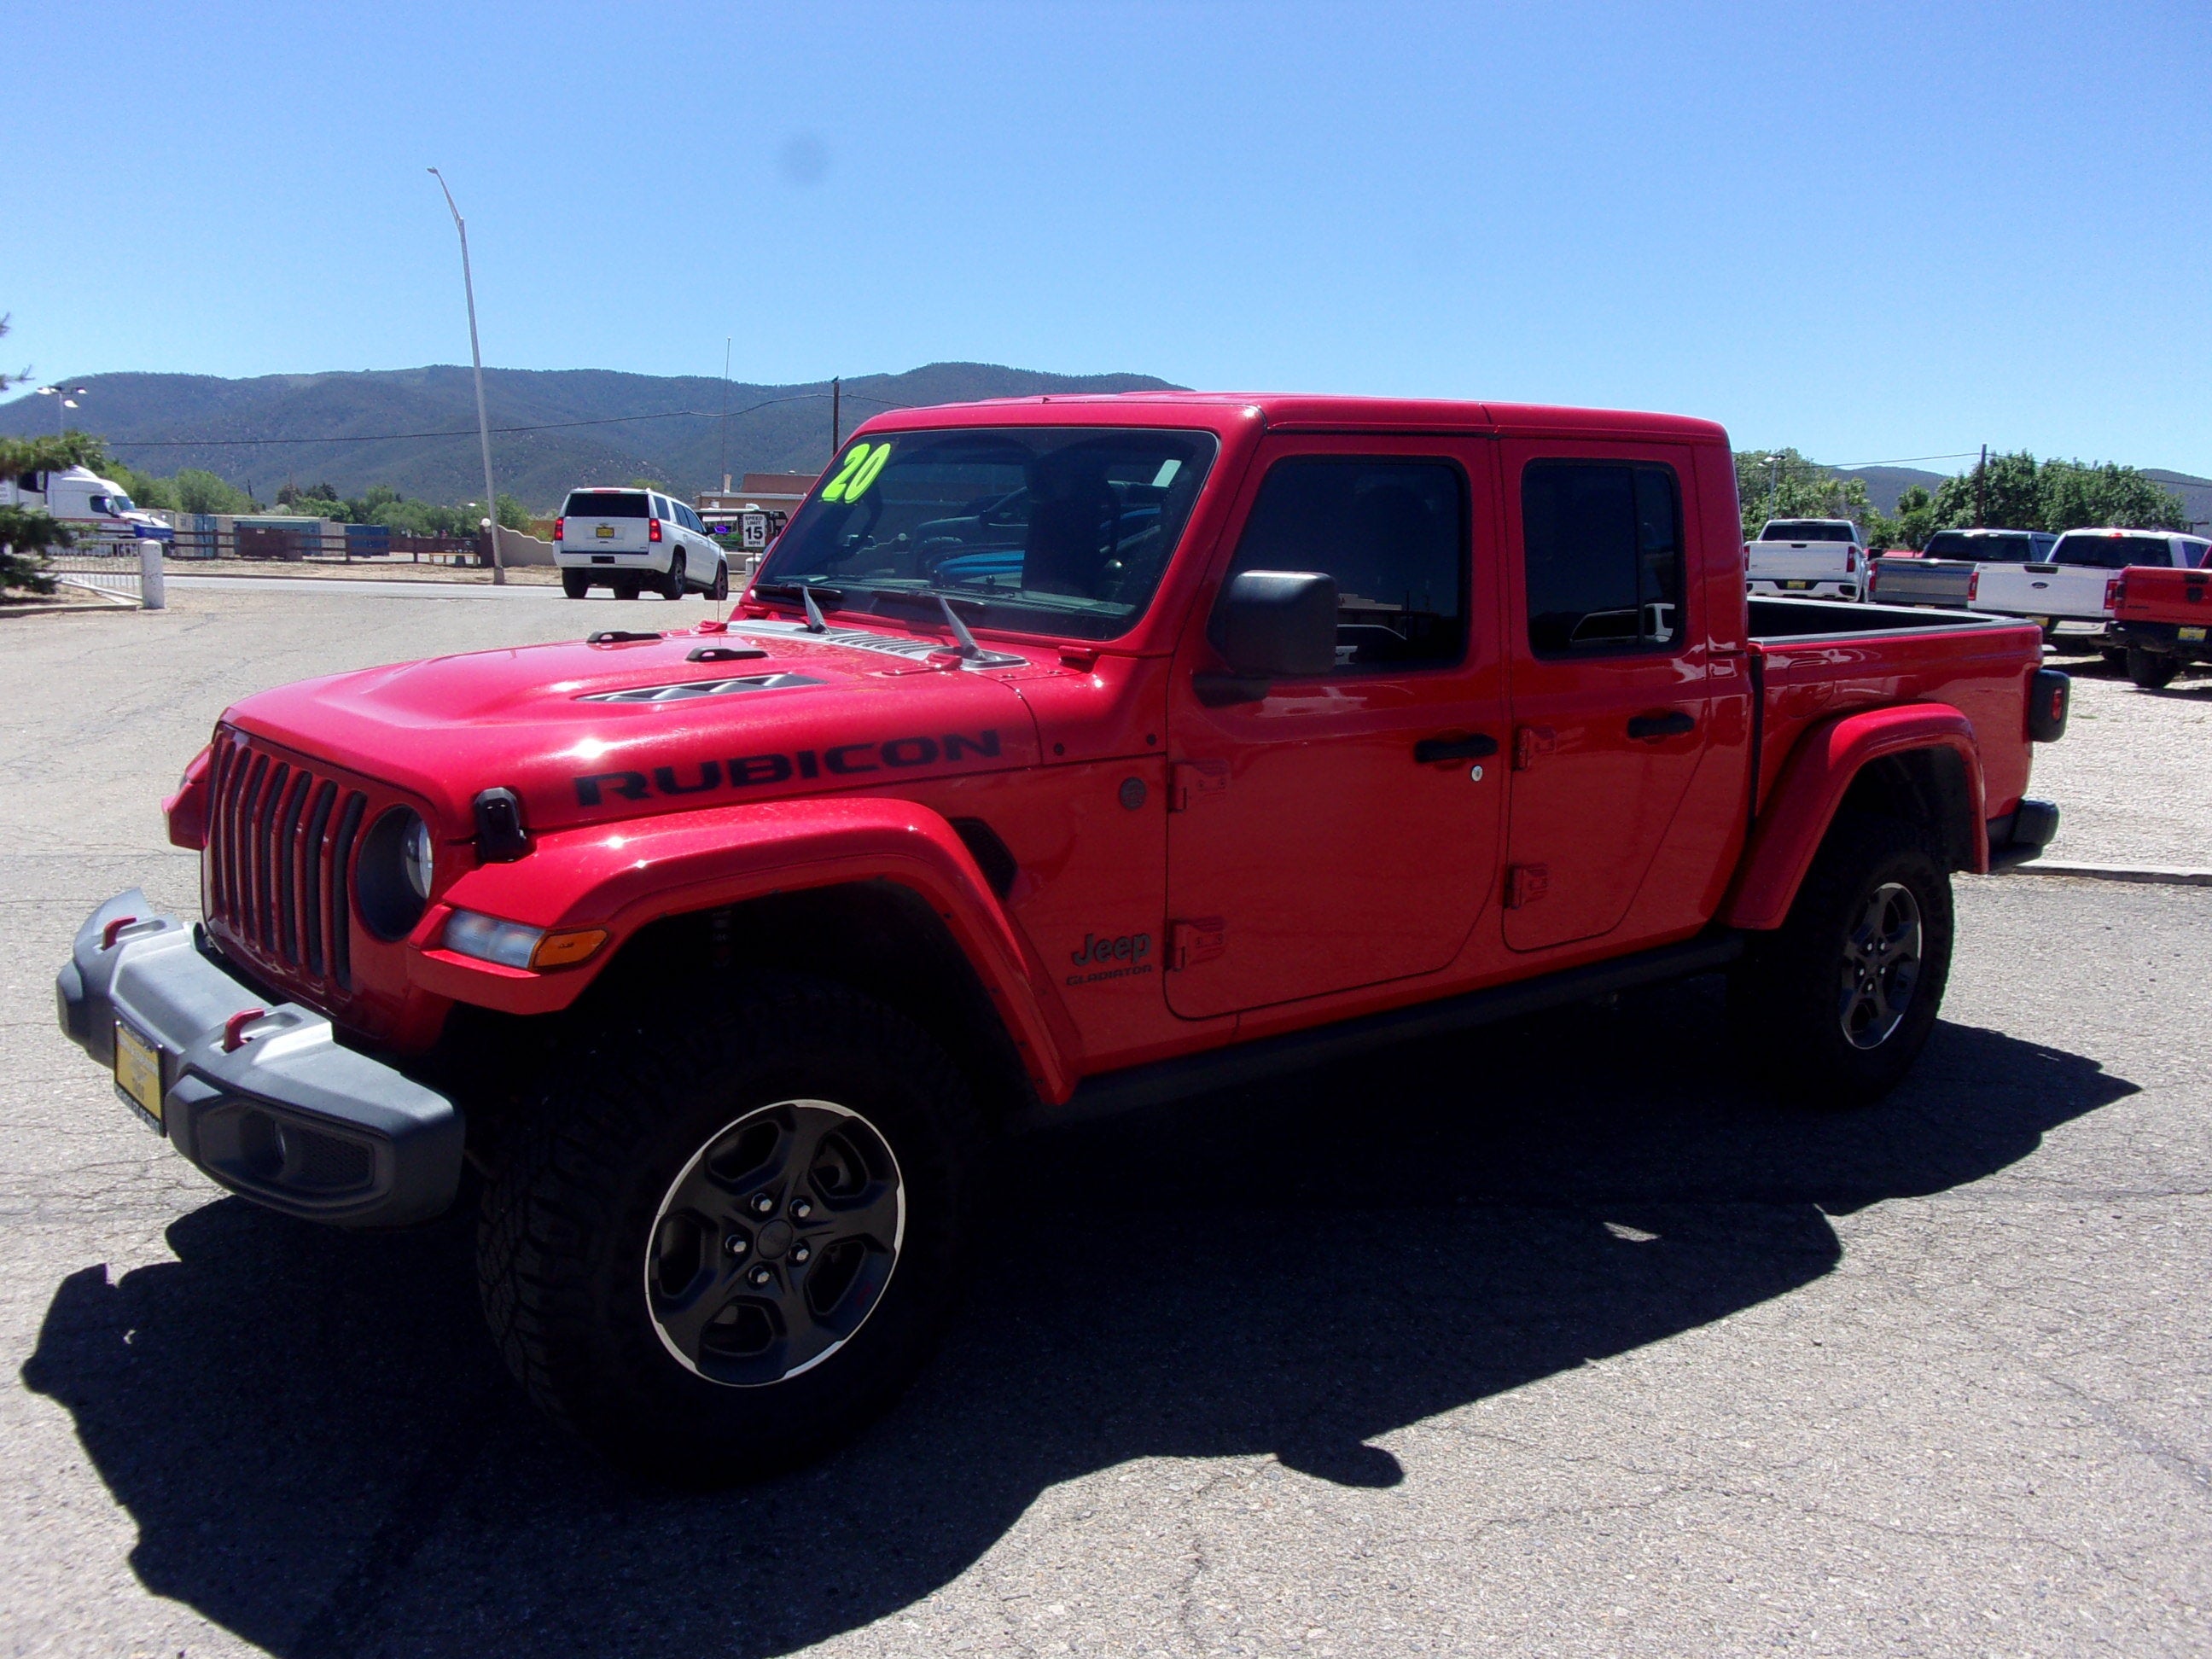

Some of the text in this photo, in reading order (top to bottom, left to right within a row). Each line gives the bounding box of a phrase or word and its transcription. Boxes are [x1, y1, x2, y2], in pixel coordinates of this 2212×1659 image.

[821, 443, 891, 504] 20
[745, 526, 763, 539] 15
[573, 730, 1000, 806] RUBICON
[1072, 933, 1150, 966] Jeep
[1067, 964, 1151, 985] GLADIATOR
